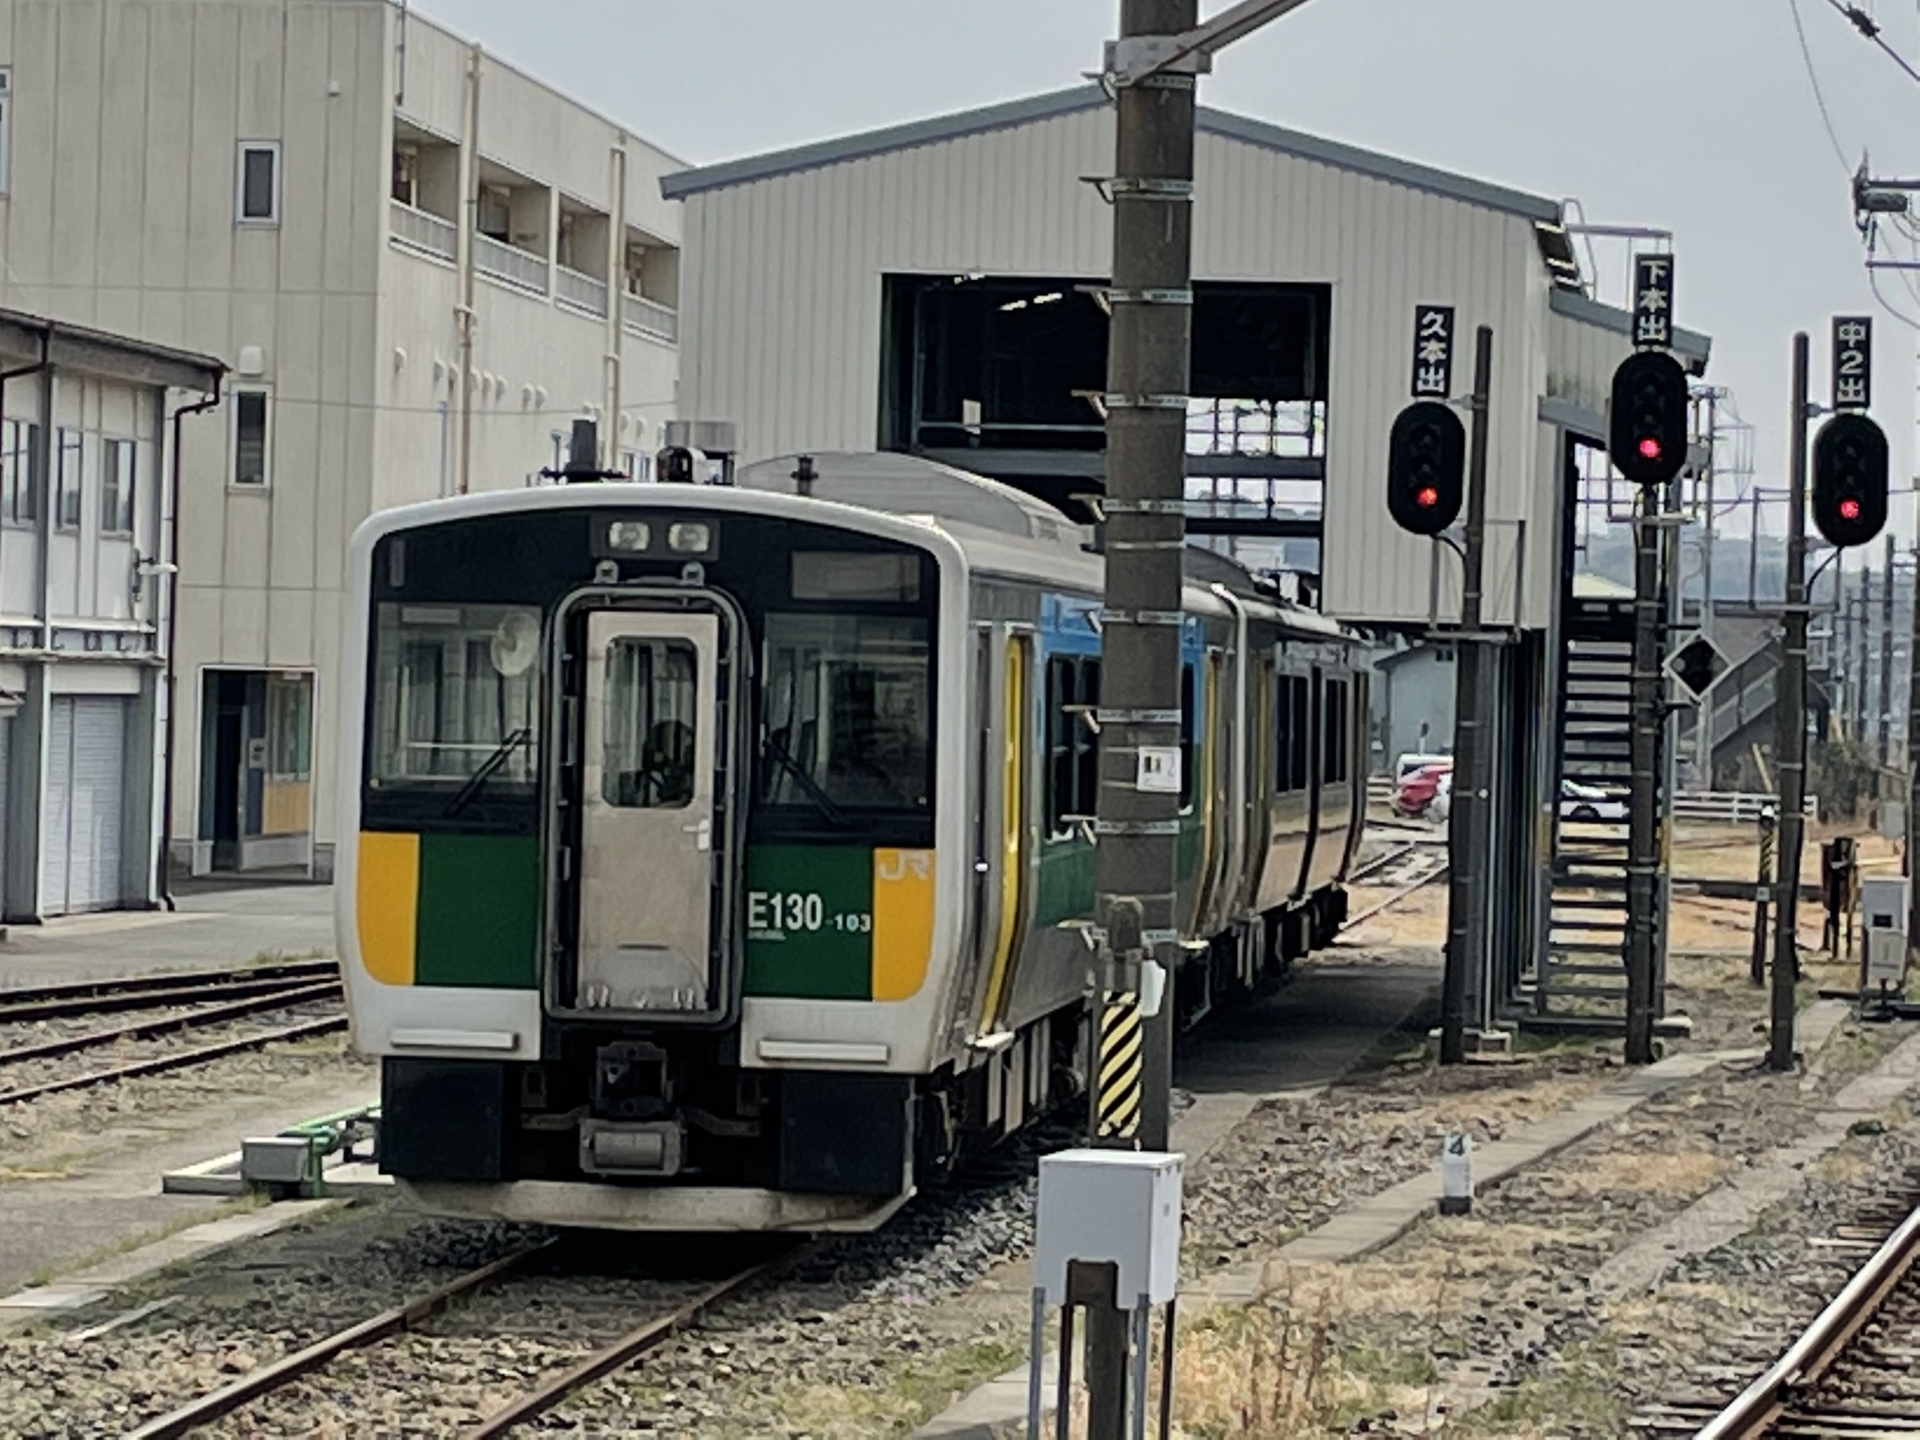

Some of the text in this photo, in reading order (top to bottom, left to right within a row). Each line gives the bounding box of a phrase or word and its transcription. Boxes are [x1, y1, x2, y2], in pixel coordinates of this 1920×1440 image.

[1638, 260, 1669, 341] 下本出
[1417, 311, 1447, 392] 久本出
[1837, 321, 1866, 402] 中2出
[879, 849, 931, 880] JR
[1448, 1136, 1465, 1157] 4
